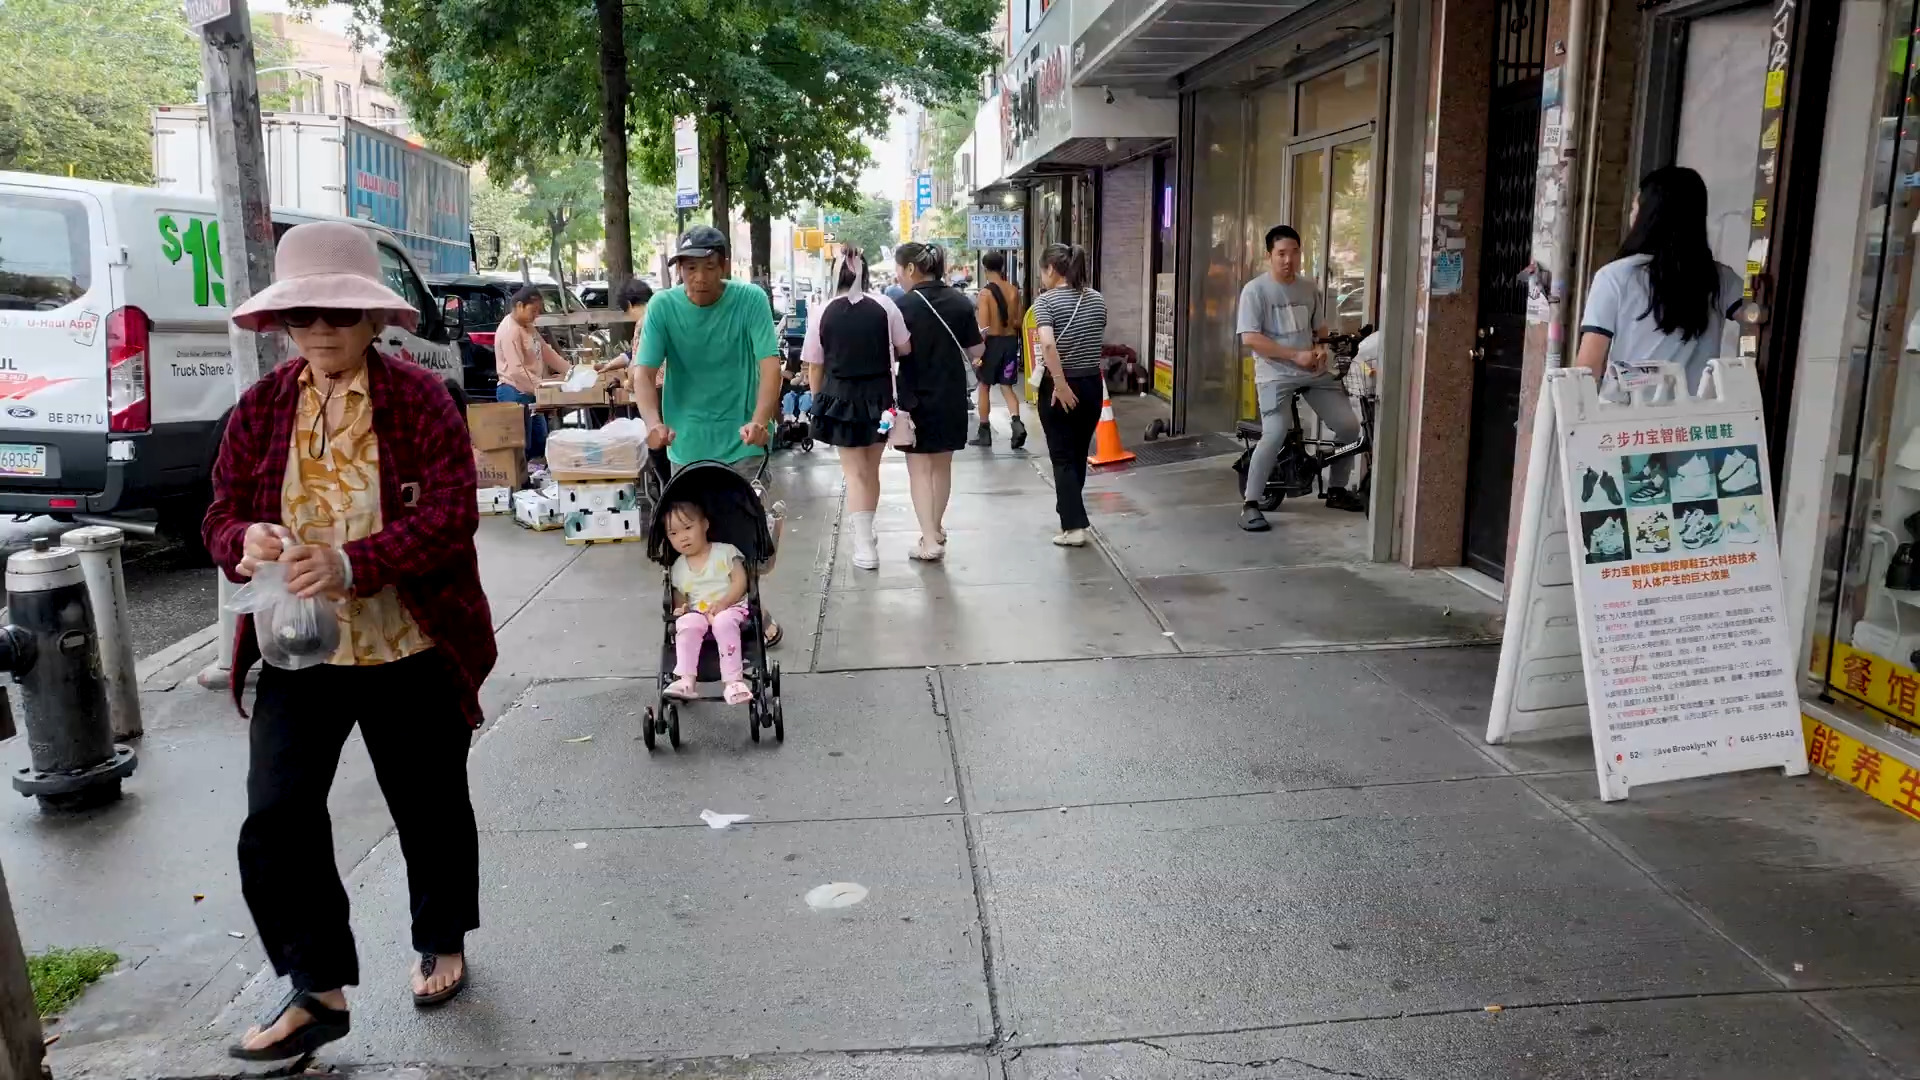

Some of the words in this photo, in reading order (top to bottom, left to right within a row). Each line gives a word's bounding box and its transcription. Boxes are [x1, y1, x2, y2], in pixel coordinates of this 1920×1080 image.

[69, 319, 92, 329] App
[171, 363, 198, 377] Truck
[199, 363, 225, 377] Share
[48, 412, 63, 423] BE
[66, 413, 92, 424] 8717
